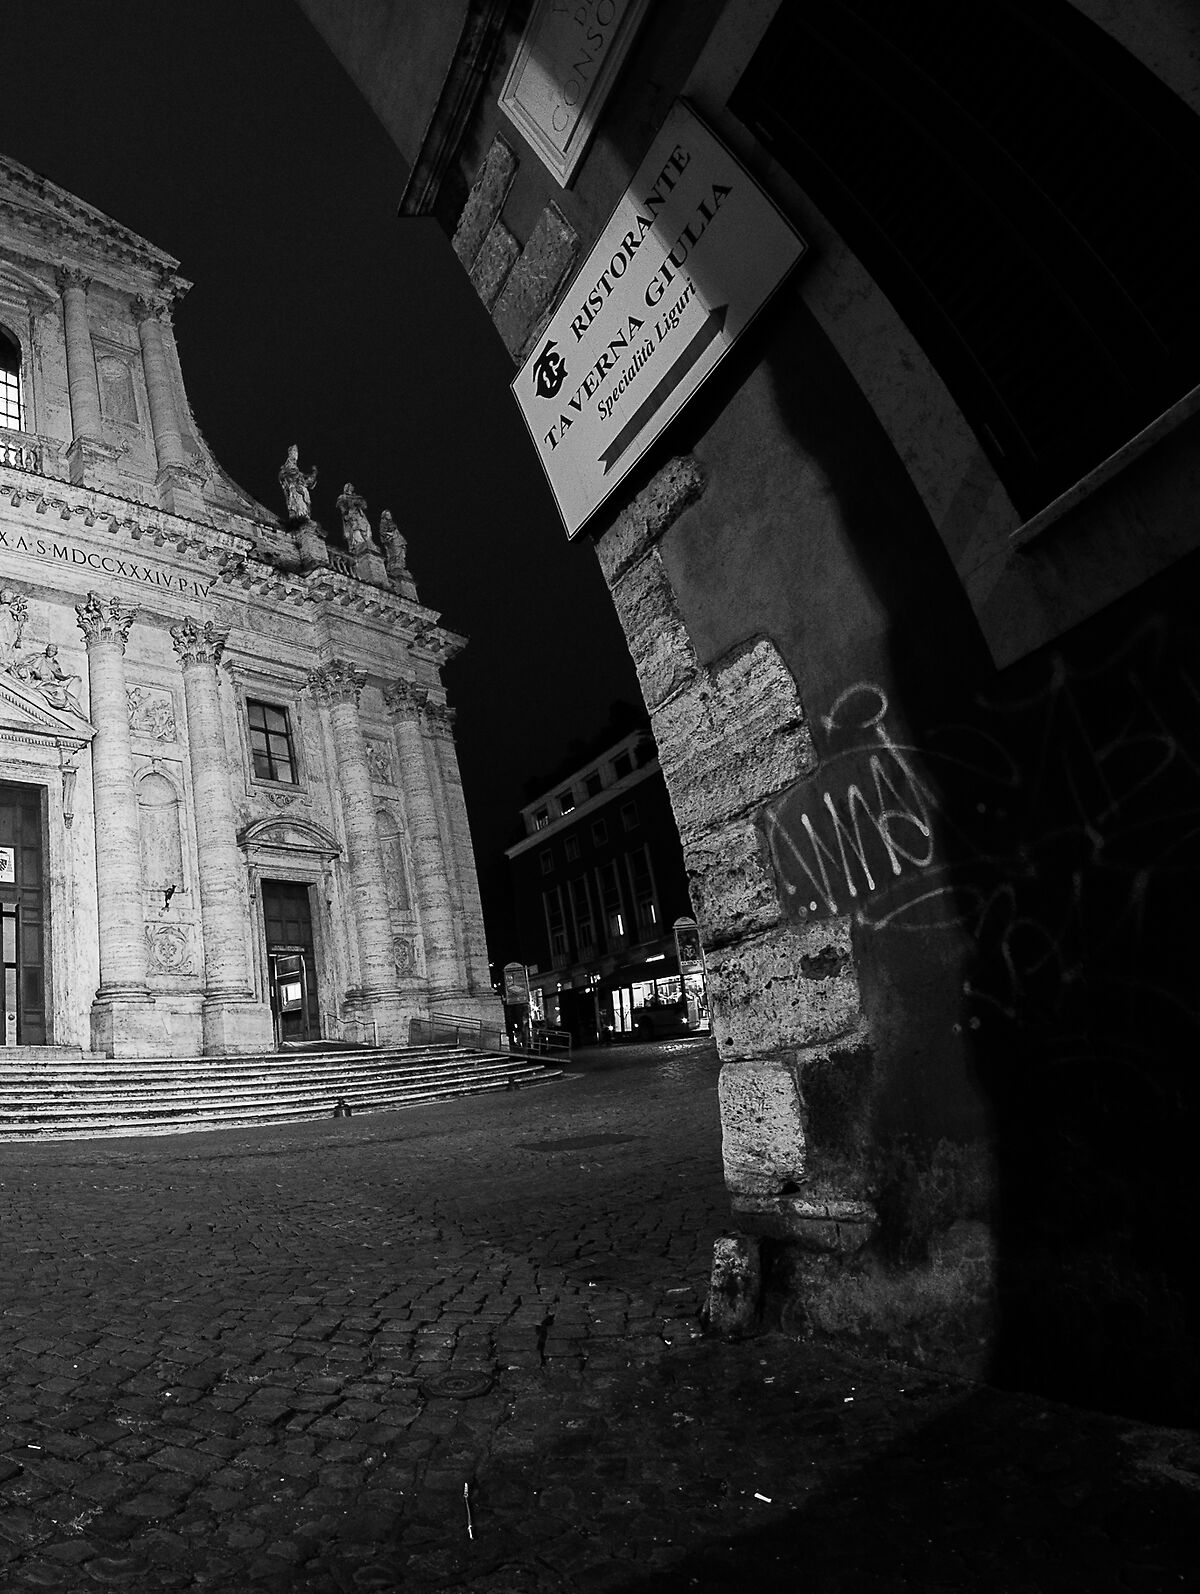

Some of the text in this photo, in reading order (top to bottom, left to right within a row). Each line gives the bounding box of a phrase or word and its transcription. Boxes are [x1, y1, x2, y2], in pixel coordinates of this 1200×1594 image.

[543, 183, 734, 452] TAVERNA GIULIA
[569, 144, 691, 343] RISTORANTE
[597, 277, 697, 421] Specialità Liguri
